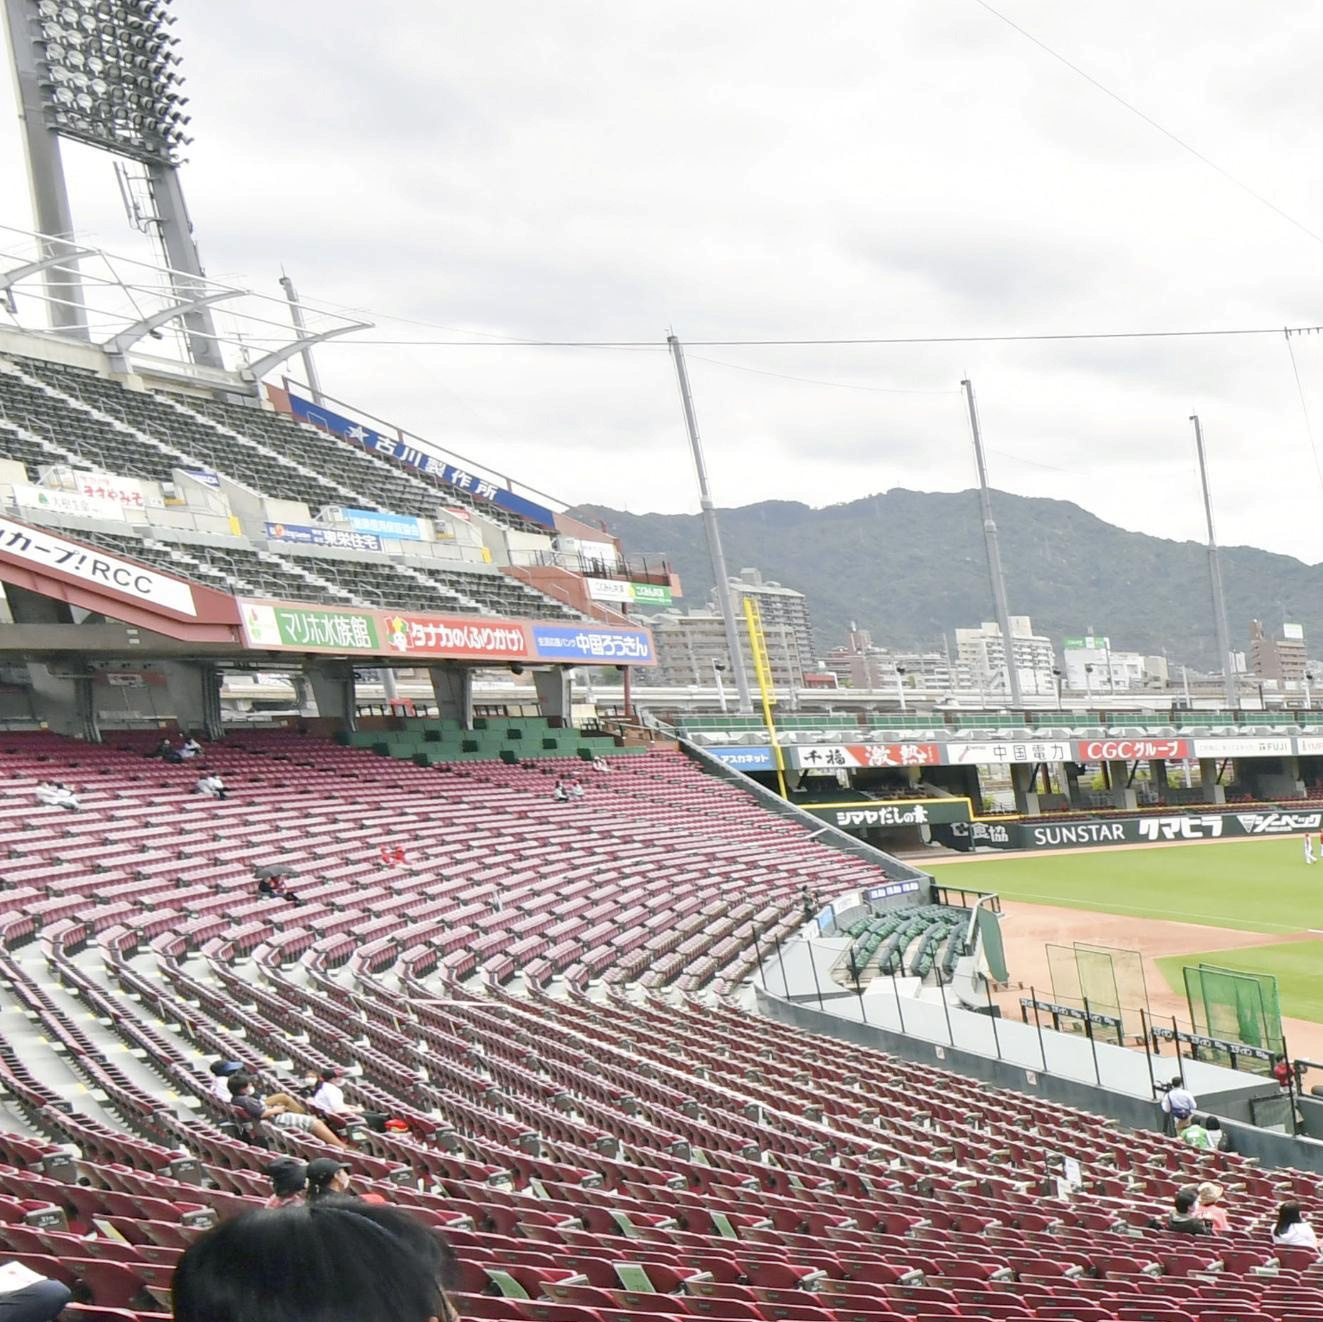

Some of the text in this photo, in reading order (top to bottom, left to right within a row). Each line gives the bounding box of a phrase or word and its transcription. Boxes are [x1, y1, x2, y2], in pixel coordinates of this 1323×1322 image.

[375, 438, 497, 500] 古川製作所
[92, 559, 152, 593] RCC
[280, 612, 371, 649] マリホ水族館
[577, 632, 649, 657] 中国ろうきん
[993, 744, 1065, 760] 中国電力
[1087, 742, 1132, 759] CGC
[1133, 741, 1180, 757] グループ
[1266, 740, 1288, 750] FUJI
[719, 754, 770, 764] アスカネット
[836, 806, 928, 825] シマヤだしの素
[1033, 824, 1126, 845] SUNSTAR
